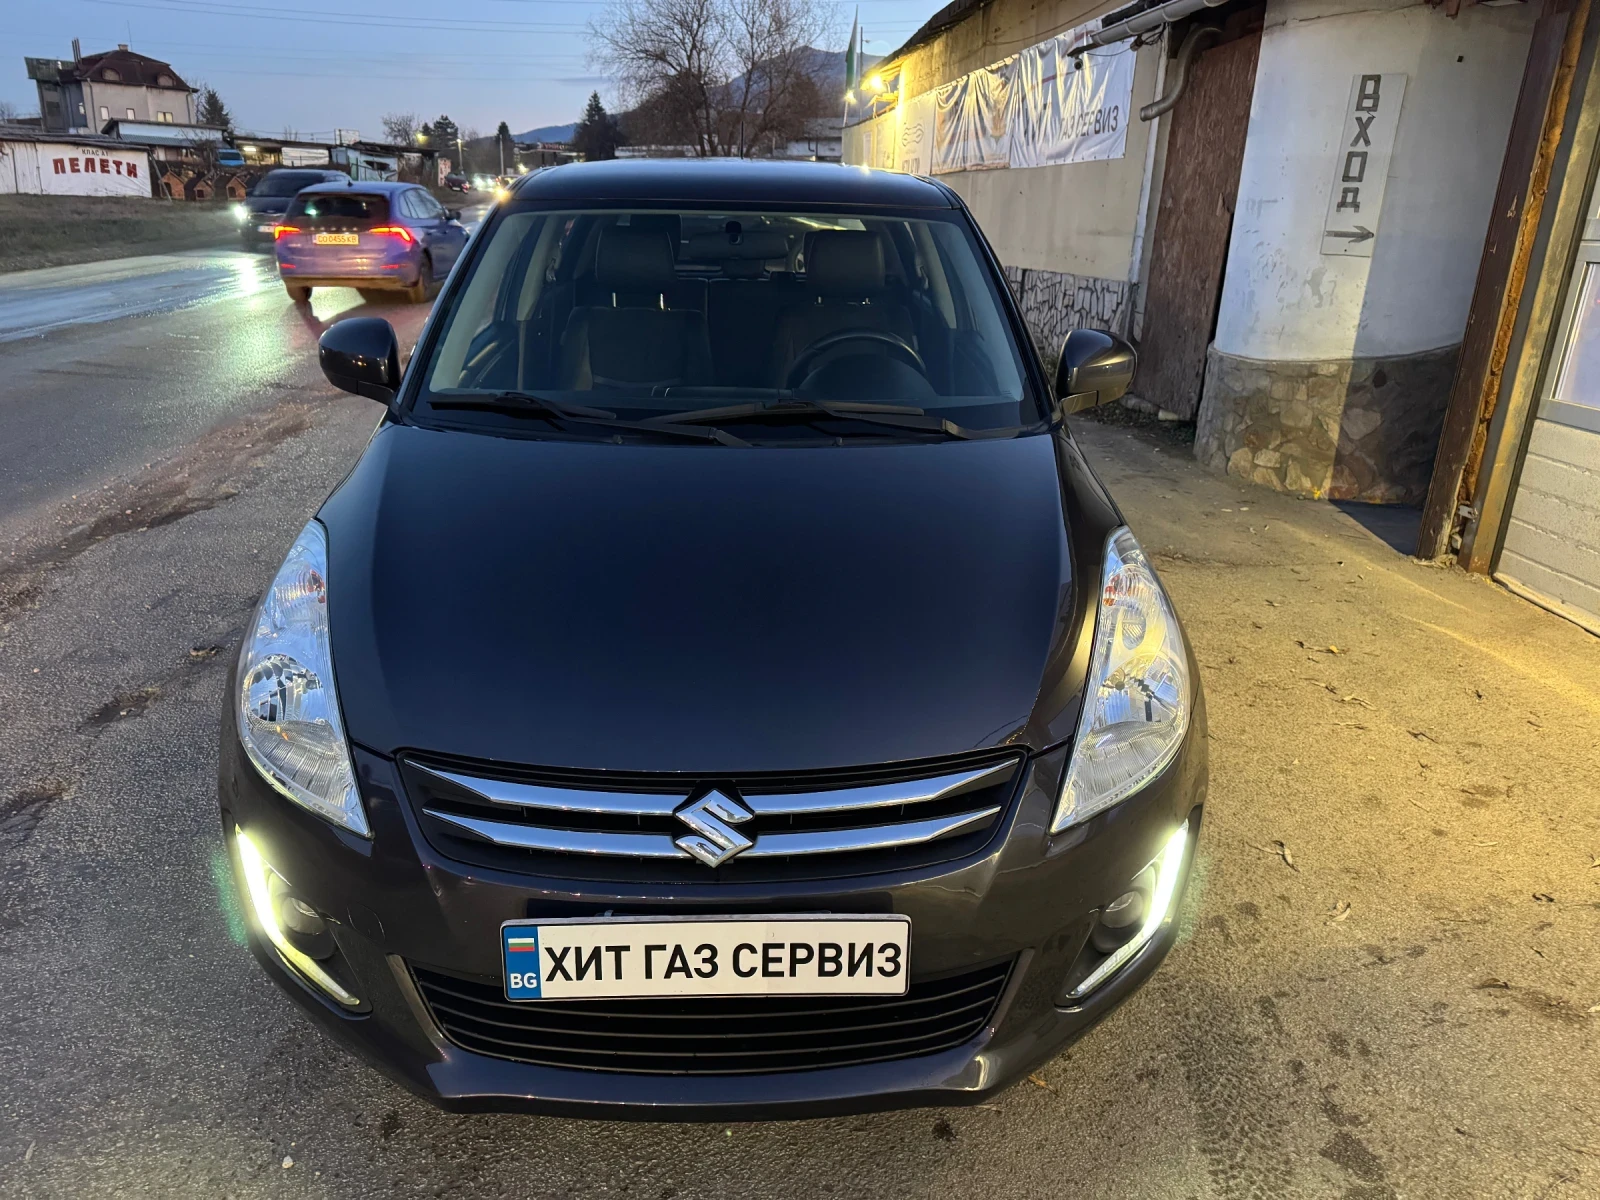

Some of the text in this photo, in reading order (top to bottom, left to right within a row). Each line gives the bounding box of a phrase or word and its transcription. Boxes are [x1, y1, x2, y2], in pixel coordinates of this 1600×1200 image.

[1336, 74, 1381, 213] ВХОД
[53, 157, 138, 178] ПЕЛЕТИ
[545, 941, 902, 982] ХИТ ГАЗ СЕРВИЗ
[510, 972, 538, 989] BG
